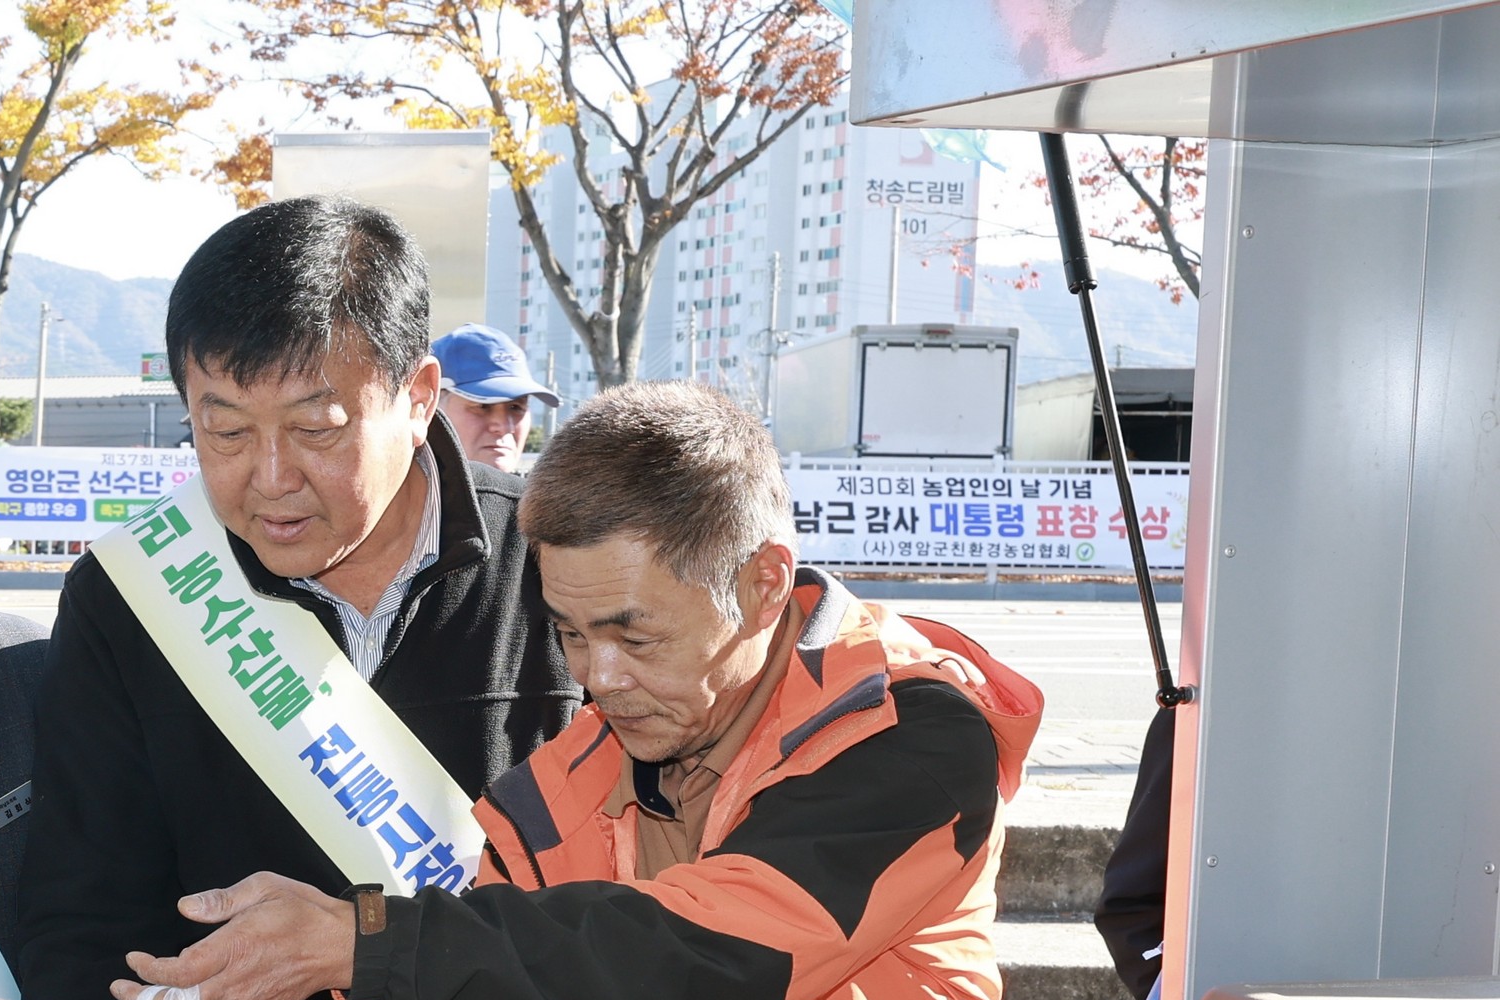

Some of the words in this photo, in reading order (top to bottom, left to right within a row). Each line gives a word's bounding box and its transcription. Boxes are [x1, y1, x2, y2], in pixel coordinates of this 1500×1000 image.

[865, 178, 964, 206] 청송드림빌
[901, 218, 928, 235] 101
[101, 453, 154, 467] 제37회
[5, 469, 81, 495] 영암군
[88, 470, 164, 495] 선수단
[836, 475, 916, 498] 제30회
[922, 476, 1014, 499] 농업인의
[1019, 477, 1043, 499] 날
[1049, 477, 1093, 500] 기념
[51, 502, 78, 517] 우승
[864, 504, 919, 535] 감사
[928, 502, 1026, 539] 대통령
[1035, 504, 1099, 539] 표창
[862, 539, 1071, 560] (사)영암군친환경농업협회
